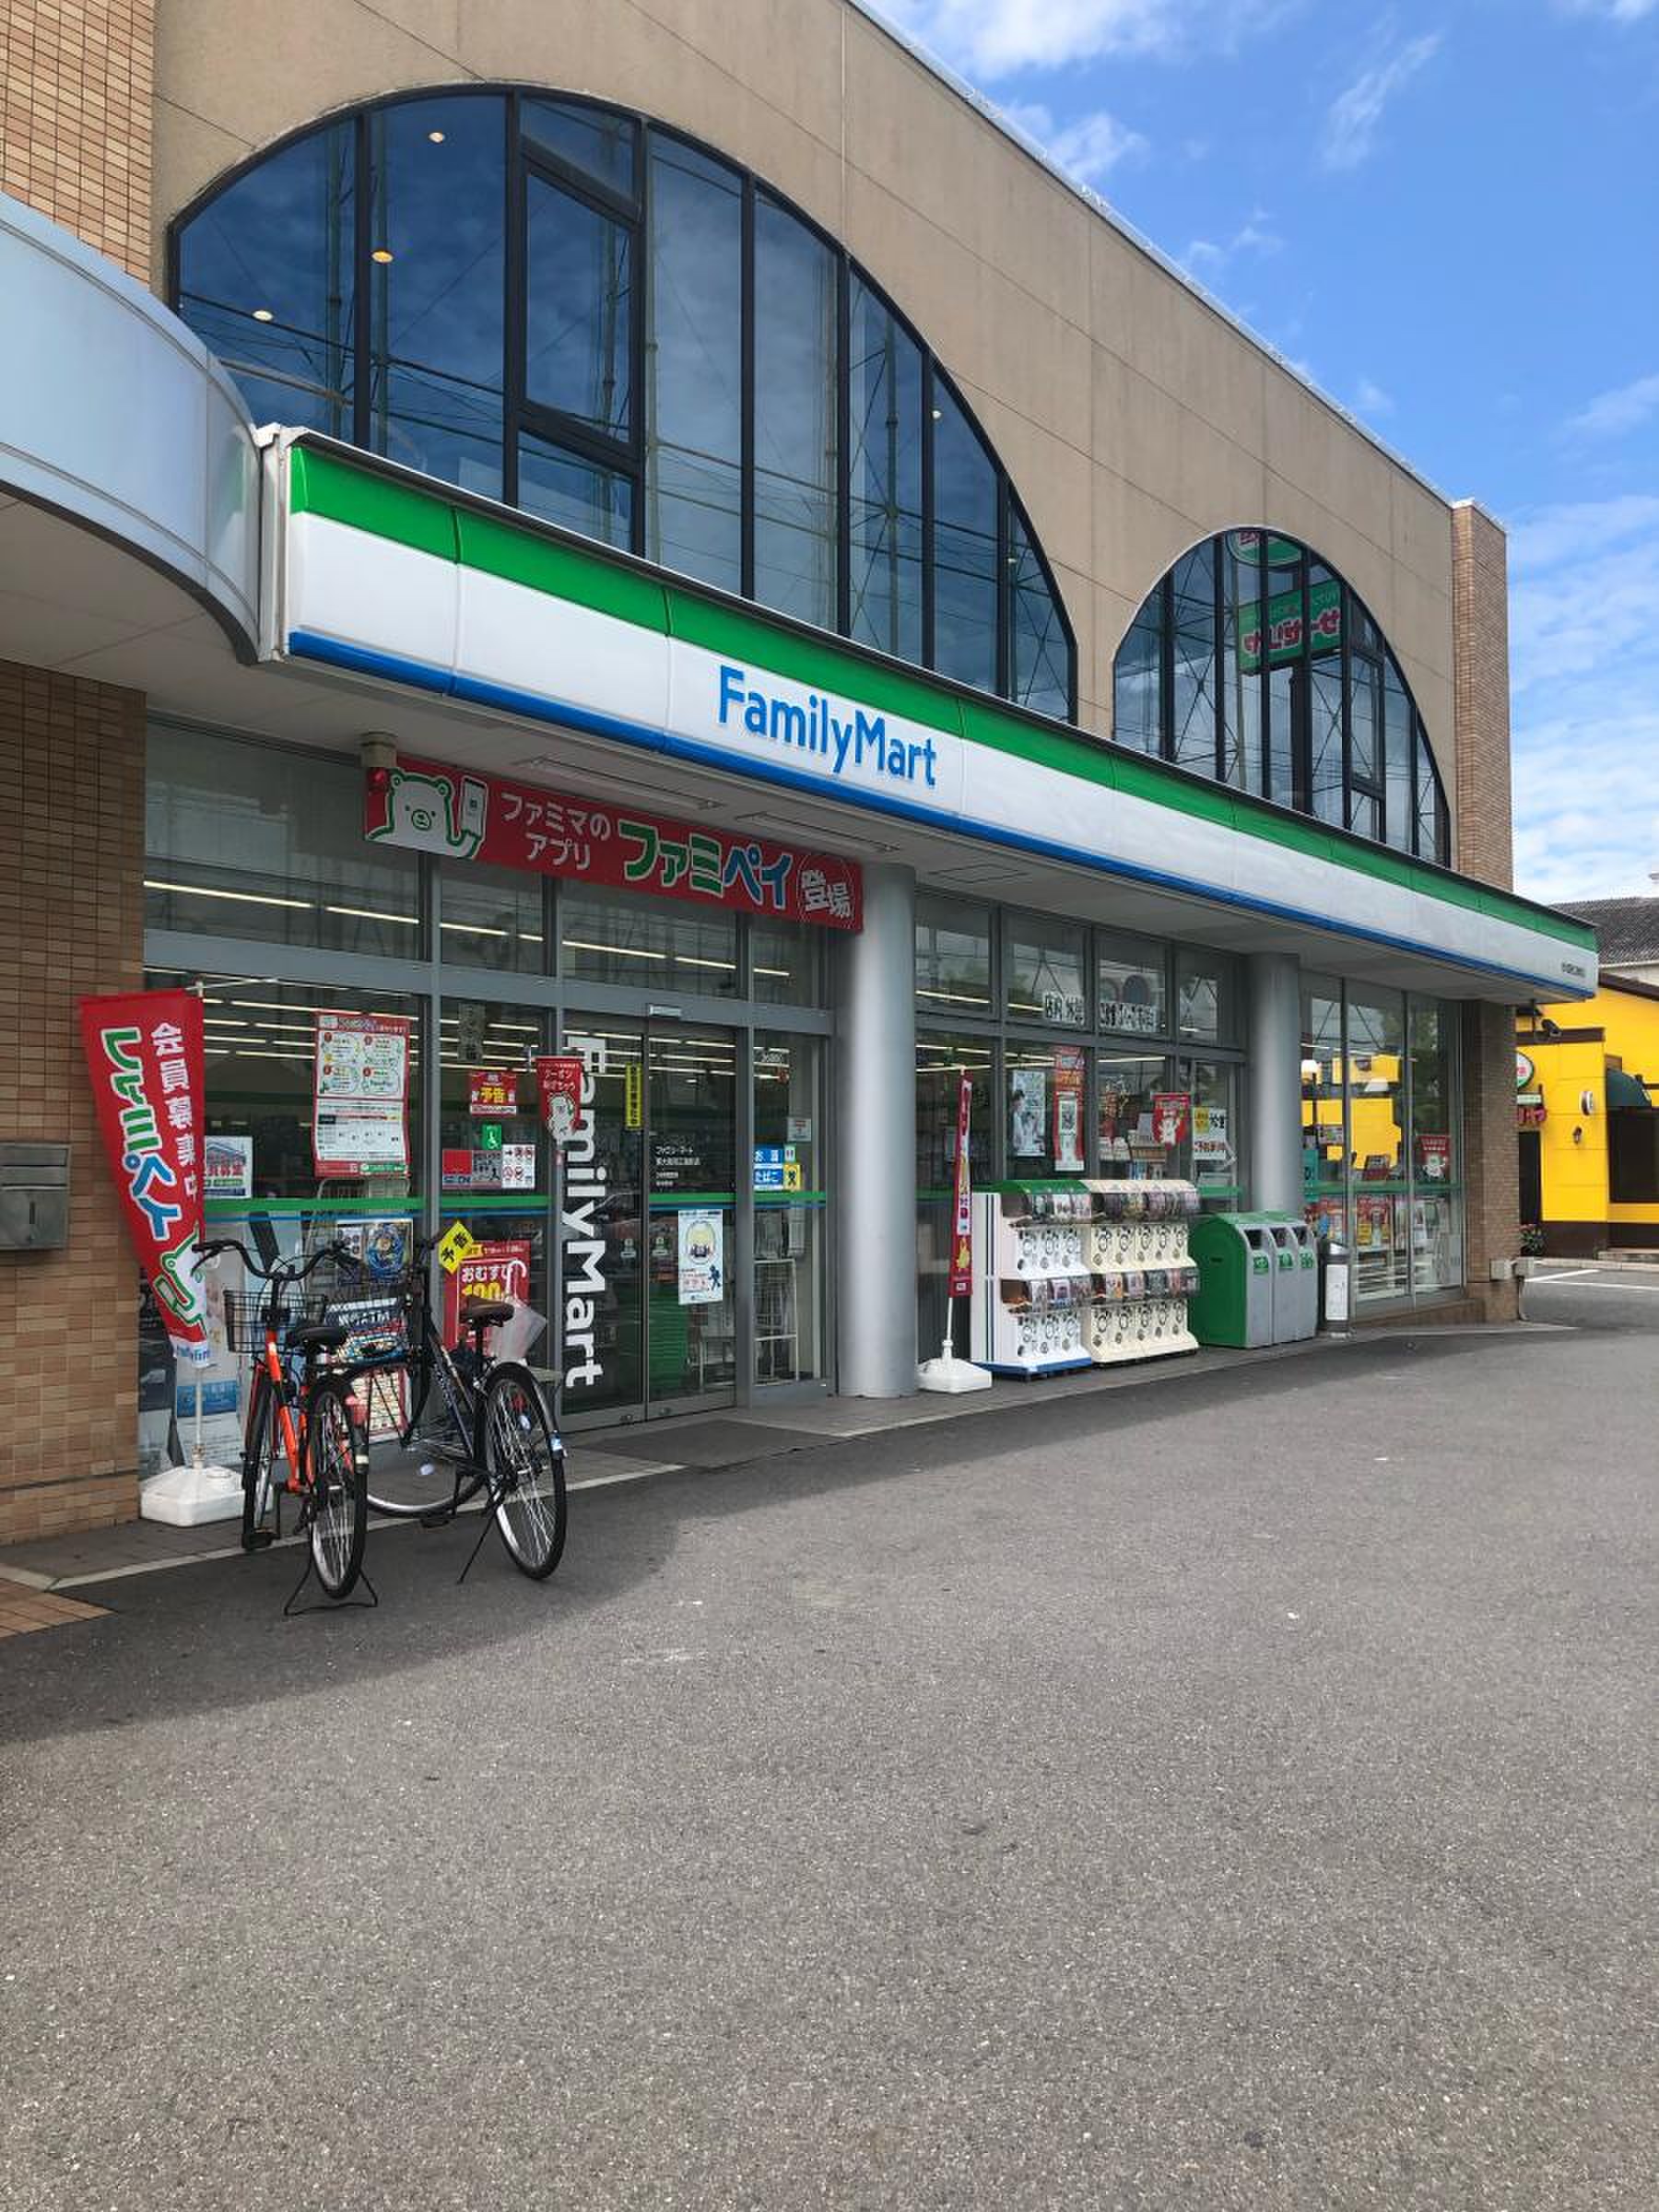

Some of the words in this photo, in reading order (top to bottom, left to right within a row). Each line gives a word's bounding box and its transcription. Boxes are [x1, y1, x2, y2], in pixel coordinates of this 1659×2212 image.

[719, 665, 936, 786] FamilyMart
[500, 792, 612, 842] ファミマの
[524, 831, 591, 871] アプリ
[618, 818, 794, 911] ファミペイ
[800, 868, 853, 920] 登場
